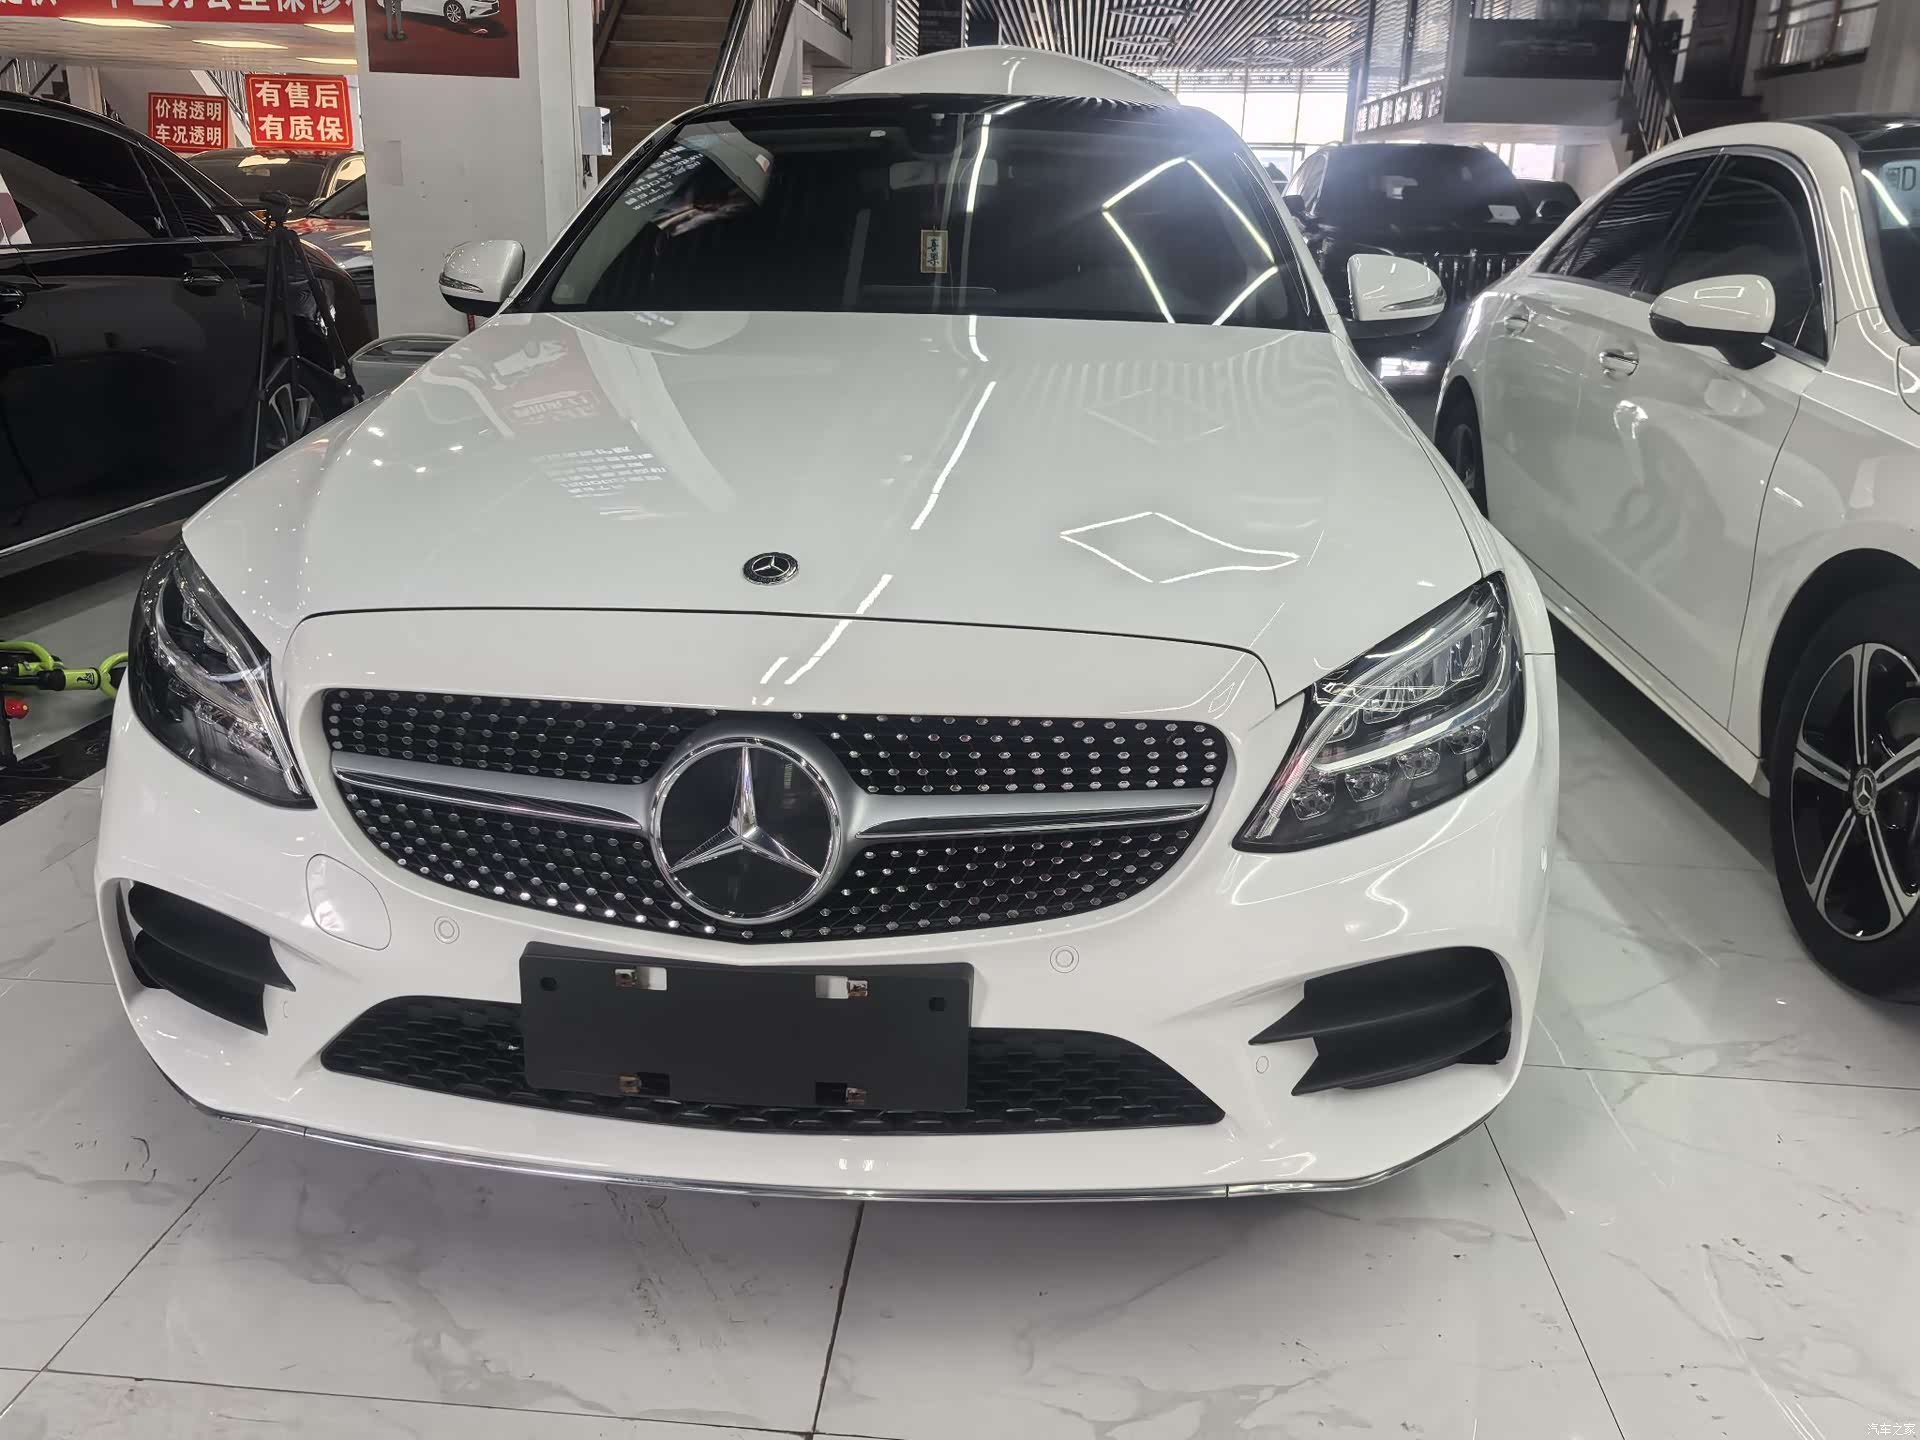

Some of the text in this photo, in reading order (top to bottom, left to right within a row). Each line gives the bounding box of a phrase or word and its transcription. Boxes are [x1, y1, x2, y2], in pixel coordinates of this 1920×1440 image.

[254, 81, 340, 108] 有售后
[155, 99, 222, 122] 价格透明
[155, 124, 222, 146] 车况透明
[258, 114, 344, 142] 有质保
